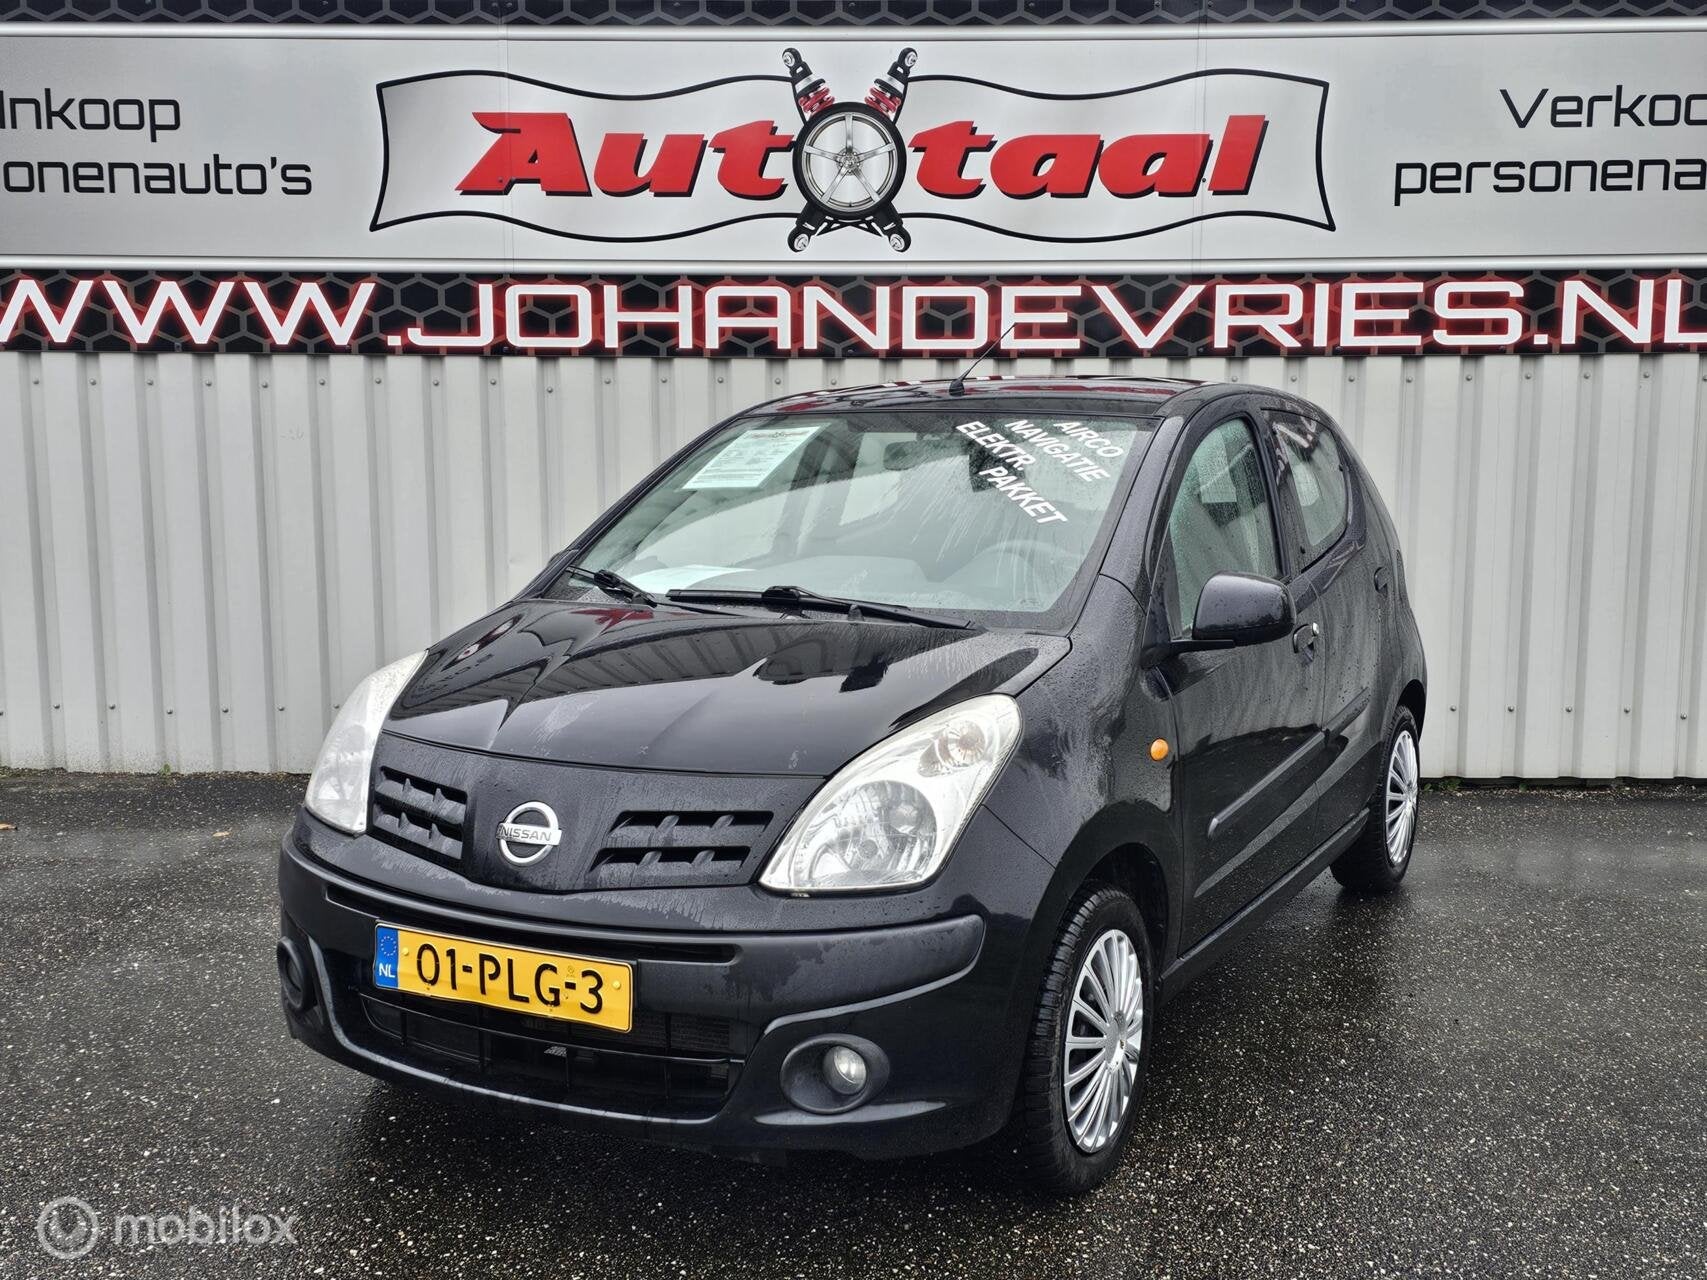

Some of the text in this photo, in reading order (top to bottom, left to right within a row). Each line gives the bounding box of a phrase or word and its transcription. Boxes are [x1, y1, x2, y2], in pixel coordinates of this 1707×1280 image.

[0, 88, 180, 142] Inkoop
[1500, 85, 1707, 128] Verkoo
[3, 154, 312, 195] onenauto's
[1394, 158, 1706, 206] personena
[0, 279, 1707, 350] WWW.JOHANDEVRIES.NL
[955, 420, 1036, 471] ELEKTR.
[1004, 419, 1111, 482] NAVIGATIE
[1053, 421, 1124, 458] AIRCO
[979, 466, 1068, 524] PAKKET
[499, 826, 552, 842] NISSAN
[378, 943, 605, 1015] NL 01-PLG-3
